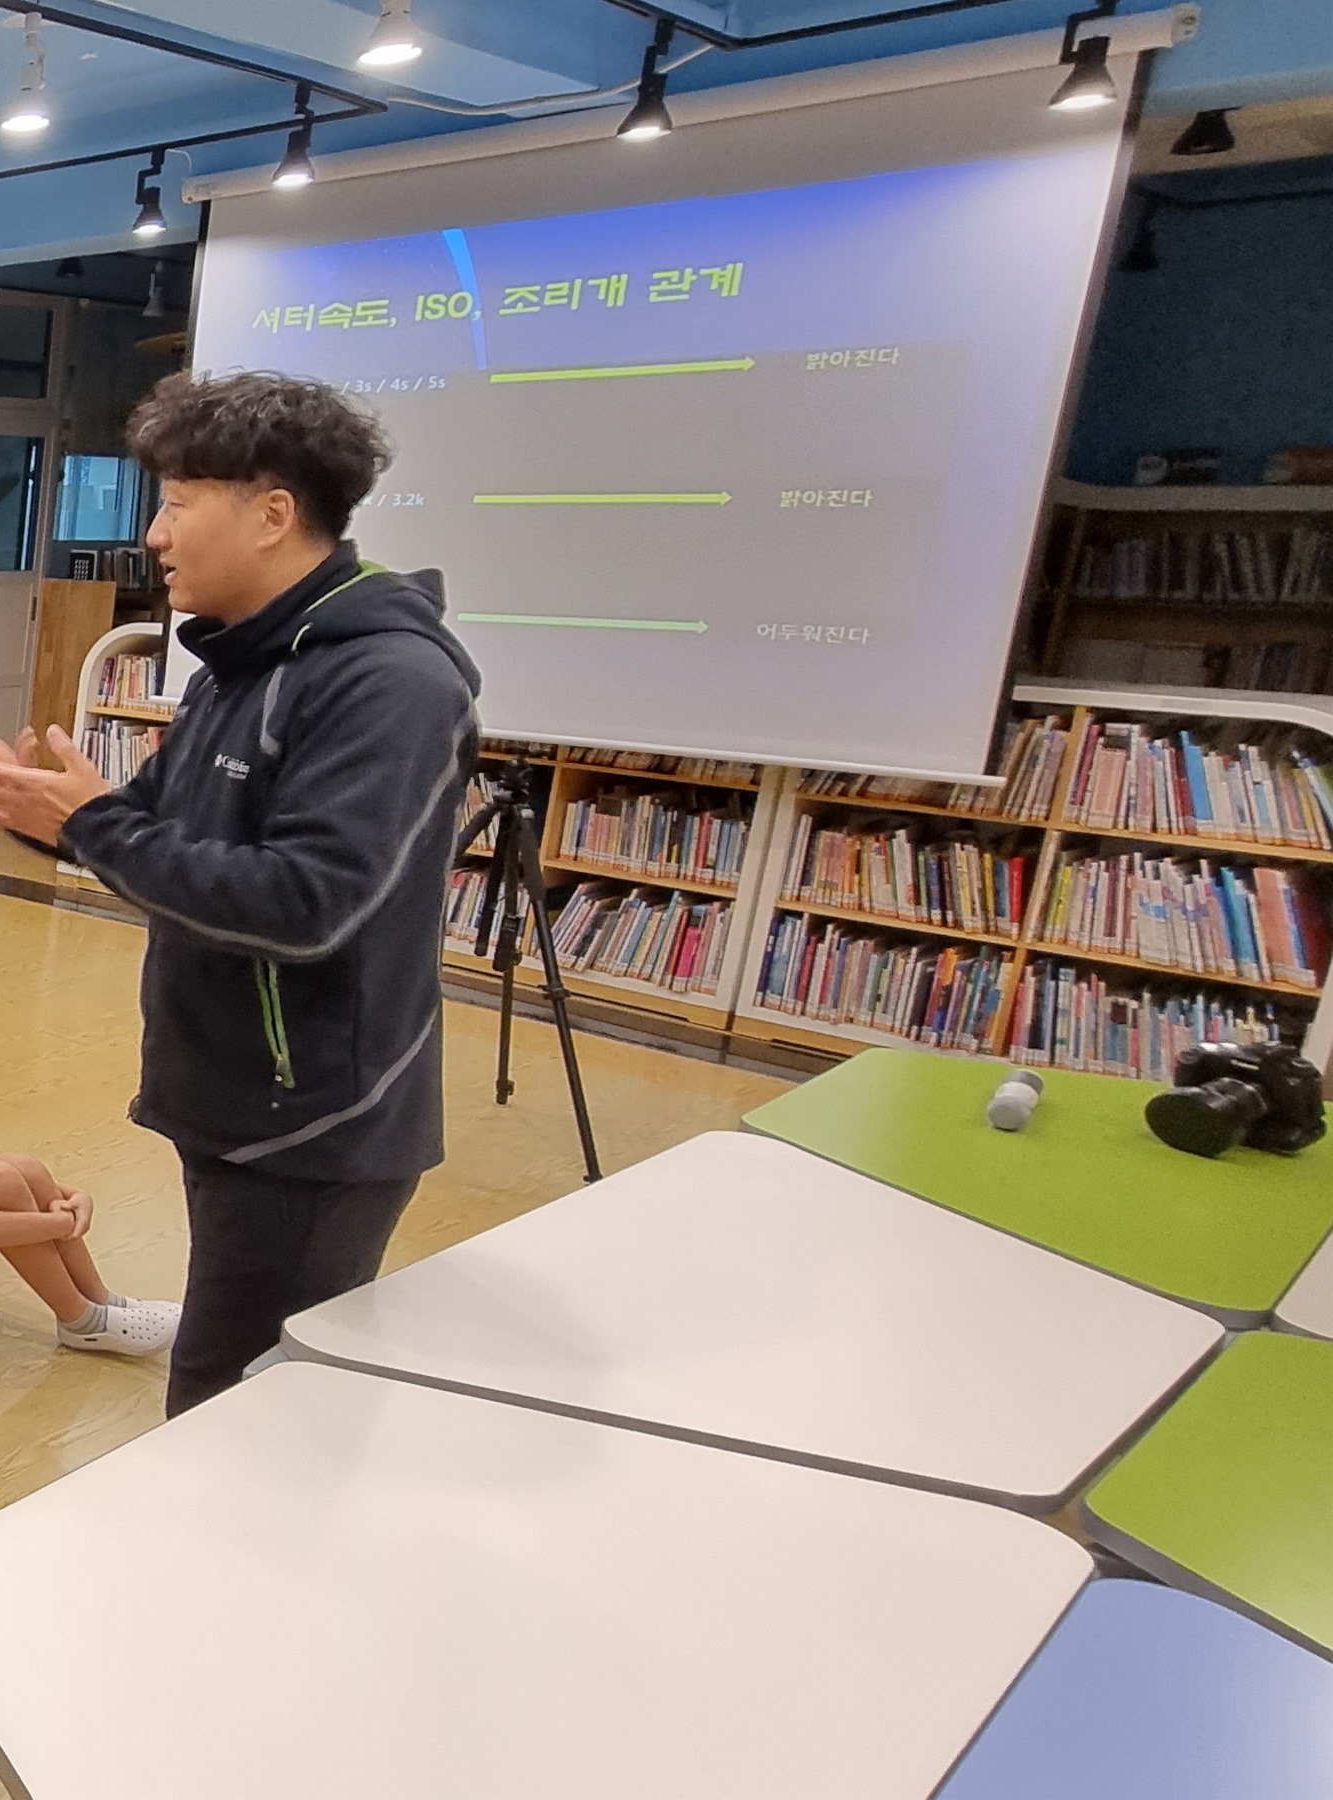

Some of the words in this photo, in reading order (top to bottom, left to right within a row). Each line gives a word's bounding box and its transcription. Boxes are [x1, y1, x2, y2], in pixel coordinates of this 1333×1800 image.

[252, 298, 398, 334] 셔터속도,
[414, 292, 482, 323] ISO,
[498, 274, 628, 317] 조리개
[649, 262, 744, 303] 관계
[805, 347, 900, 371] 밝아진다
[355, 380, 372, 393] 3s
[390, 378, 409, 391] 4s
[428, 375, 446, 390] 5s
[392, 493, 424, 507] 3.2k
[780, 489, 873, 508] 밝아진다
[756, 622, 870, 645] 어두워진다
